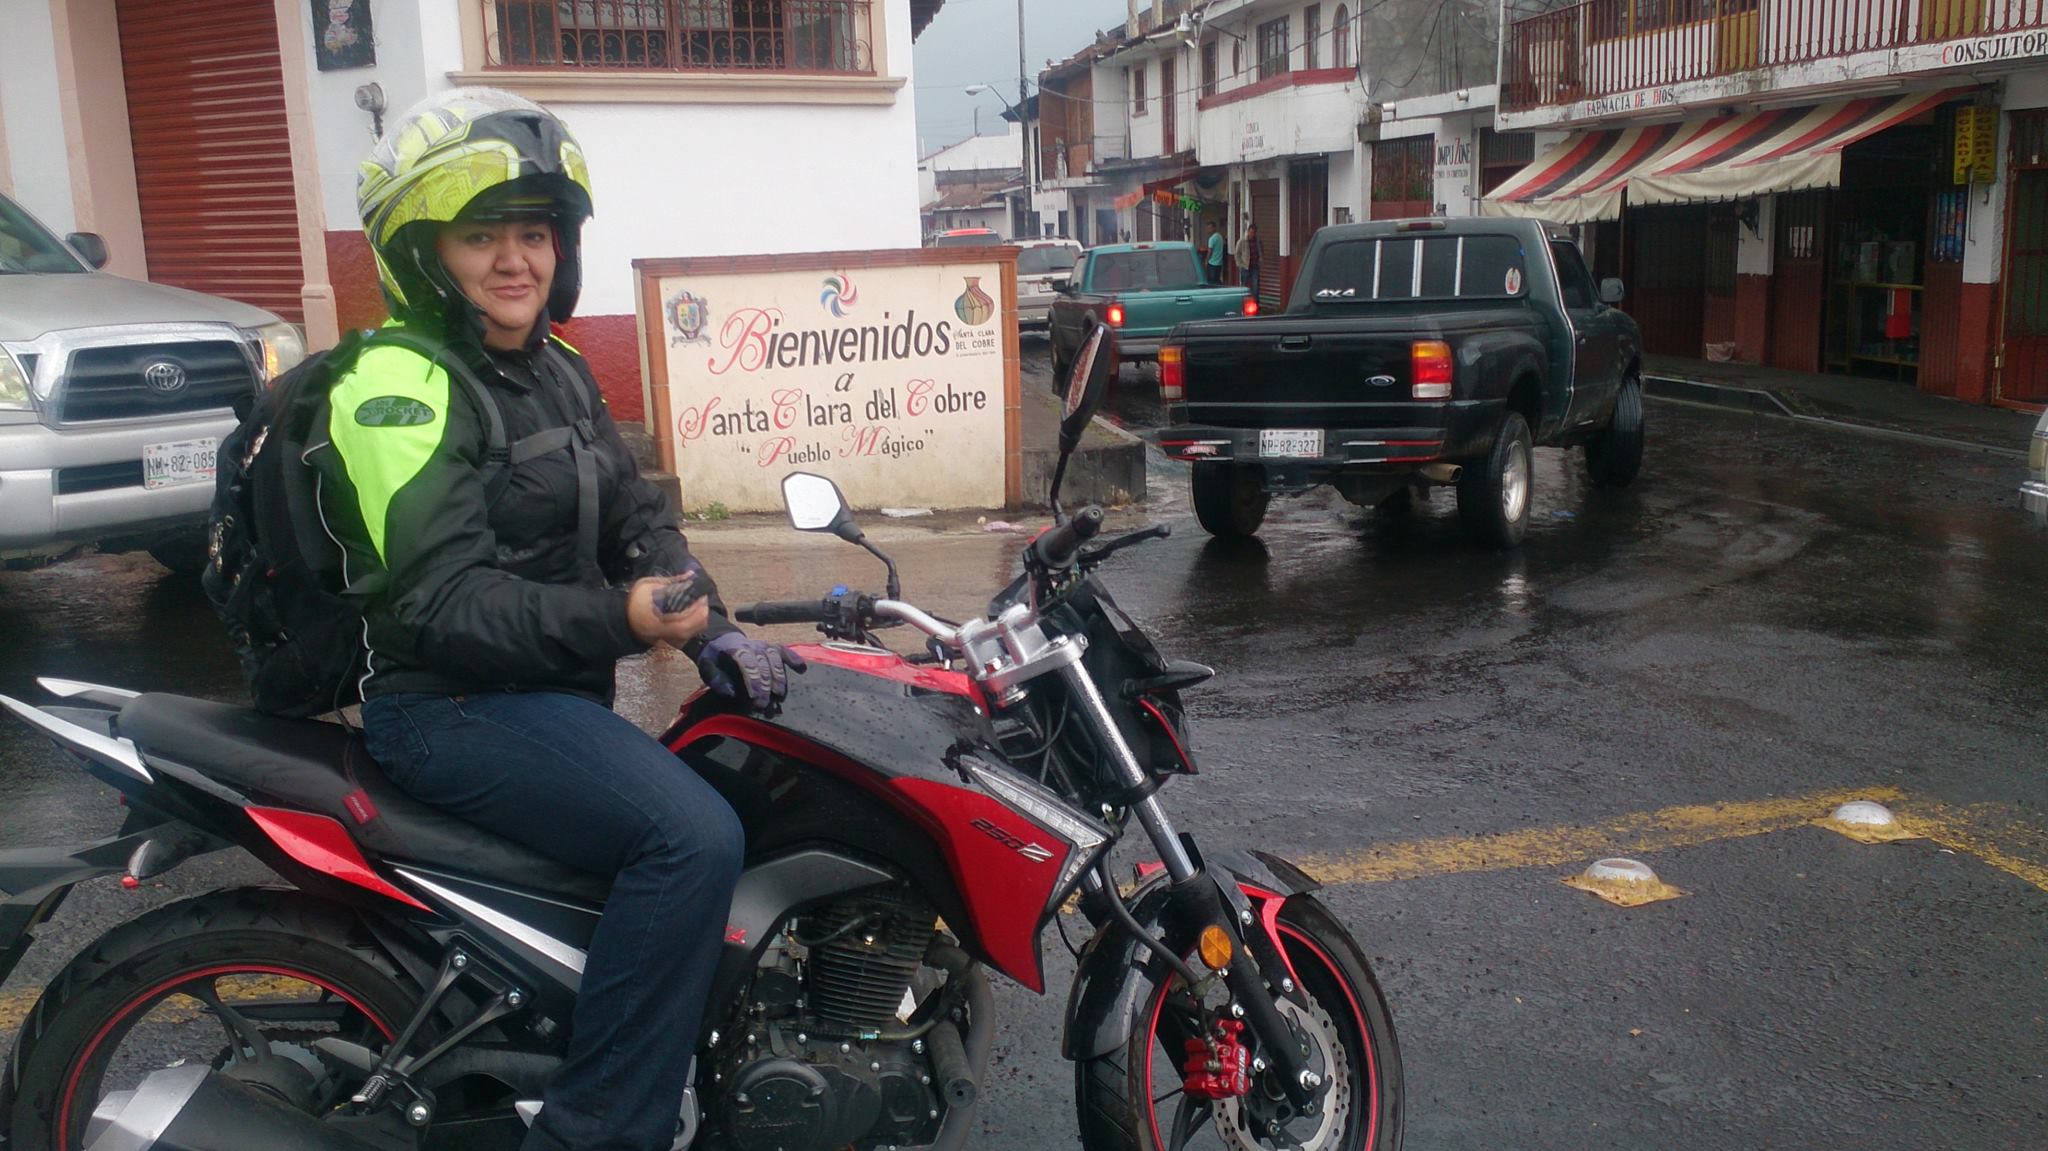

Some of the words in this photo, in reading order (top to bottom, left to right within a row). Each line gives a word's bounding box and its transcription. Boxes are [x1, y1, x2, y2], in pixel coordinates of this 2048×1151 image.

[1942, 32, 2048, 64] CONSULTOR
[1635, 92, 1646, 108] DE
[1653, 87, 1675, 105] DIOS
[708, 308, 951, 375] Bienvenidos
[955, 341, 967, 350] DEL
[972, 339, 995, 348] COBRE
[978, 329, 995, 337] CLARA
[834, 372, 855, 393] a
[678, 396, 770, 448] Santa
[771, 388, 851, 430] Clara
[866, 387, 897, 421] del
[906, 378, 986, 417] Cobre
[147, 451, 215, 478] NM-82-085
